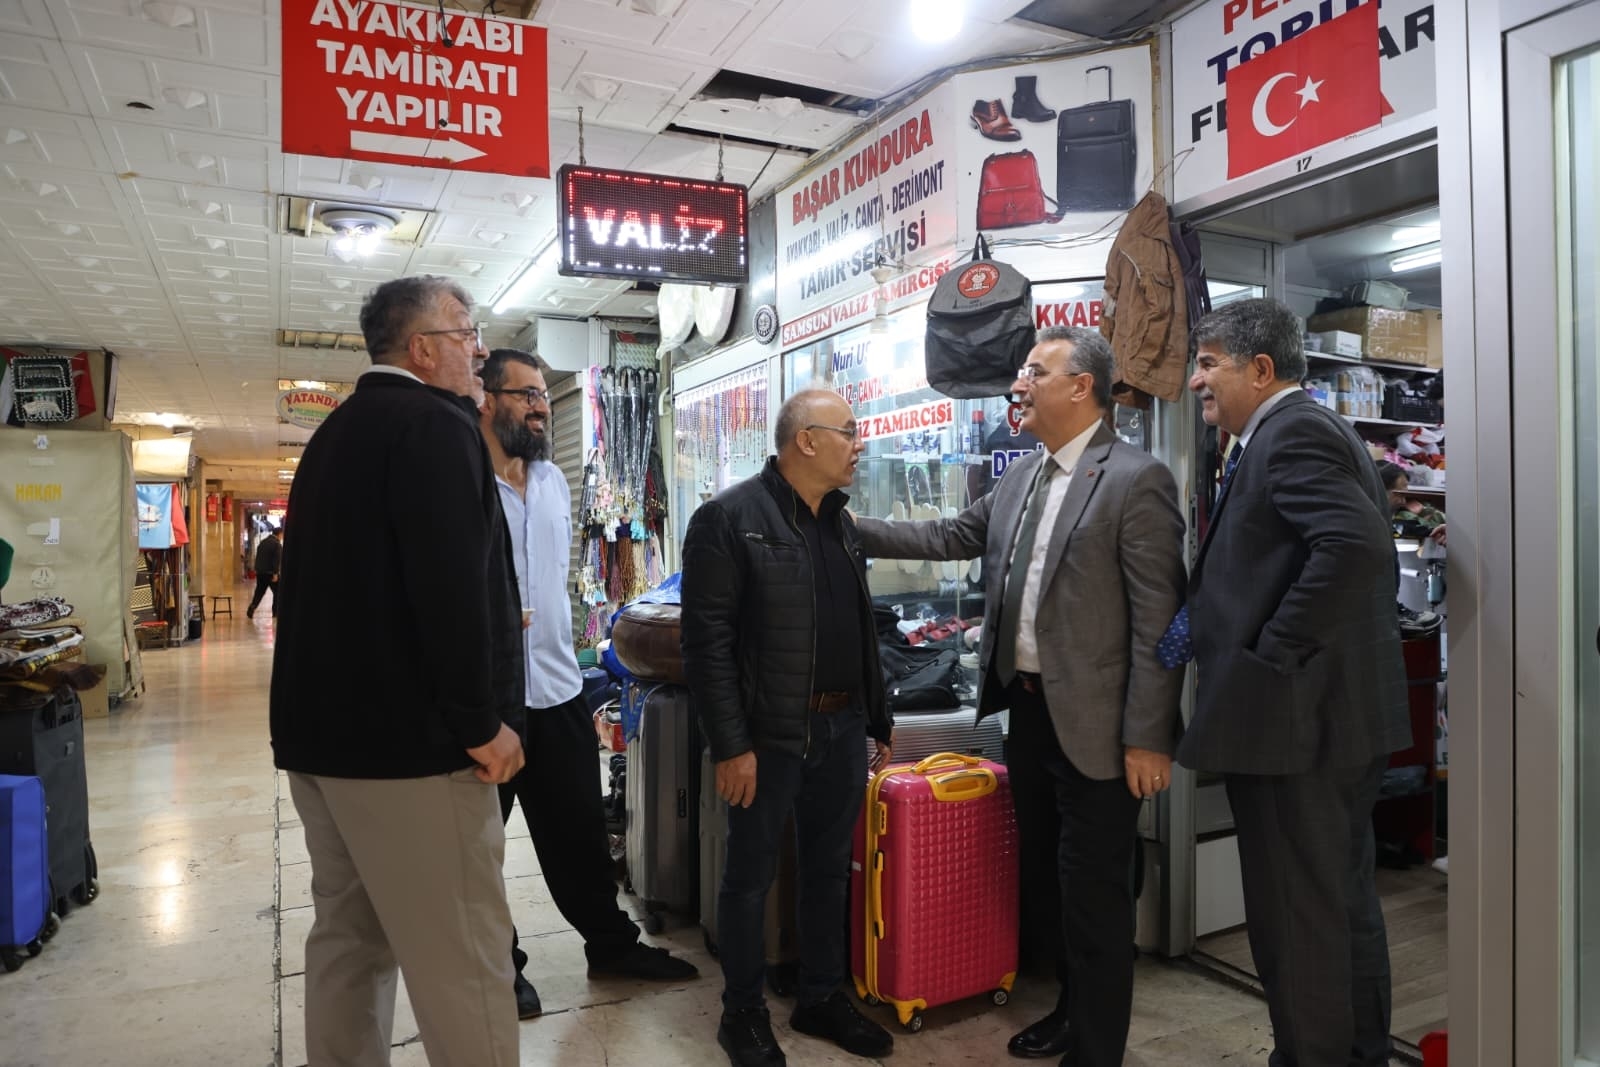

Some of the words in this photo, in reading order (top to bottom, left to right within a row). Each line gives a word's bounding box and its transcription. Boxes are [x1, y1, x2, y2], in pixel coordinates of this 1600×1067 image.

[310, 0, 523, 55] AYAKKABI
[316, 38, 518, 97] TAMİRATI
[336, 86, 503, 137] YAPILIR
[792, 167, 841, 226] BAŞAR
[843, 108, 934, 196] KUNDURA
[891, 159, 945, 215] DERİMONT
[1297, 155, 1313, 173] 17
[783, 311, 830, 343] SAMSUN
[832, 346, 854, 373] Nuri
[284, 392, 340, 409] VATANDA
